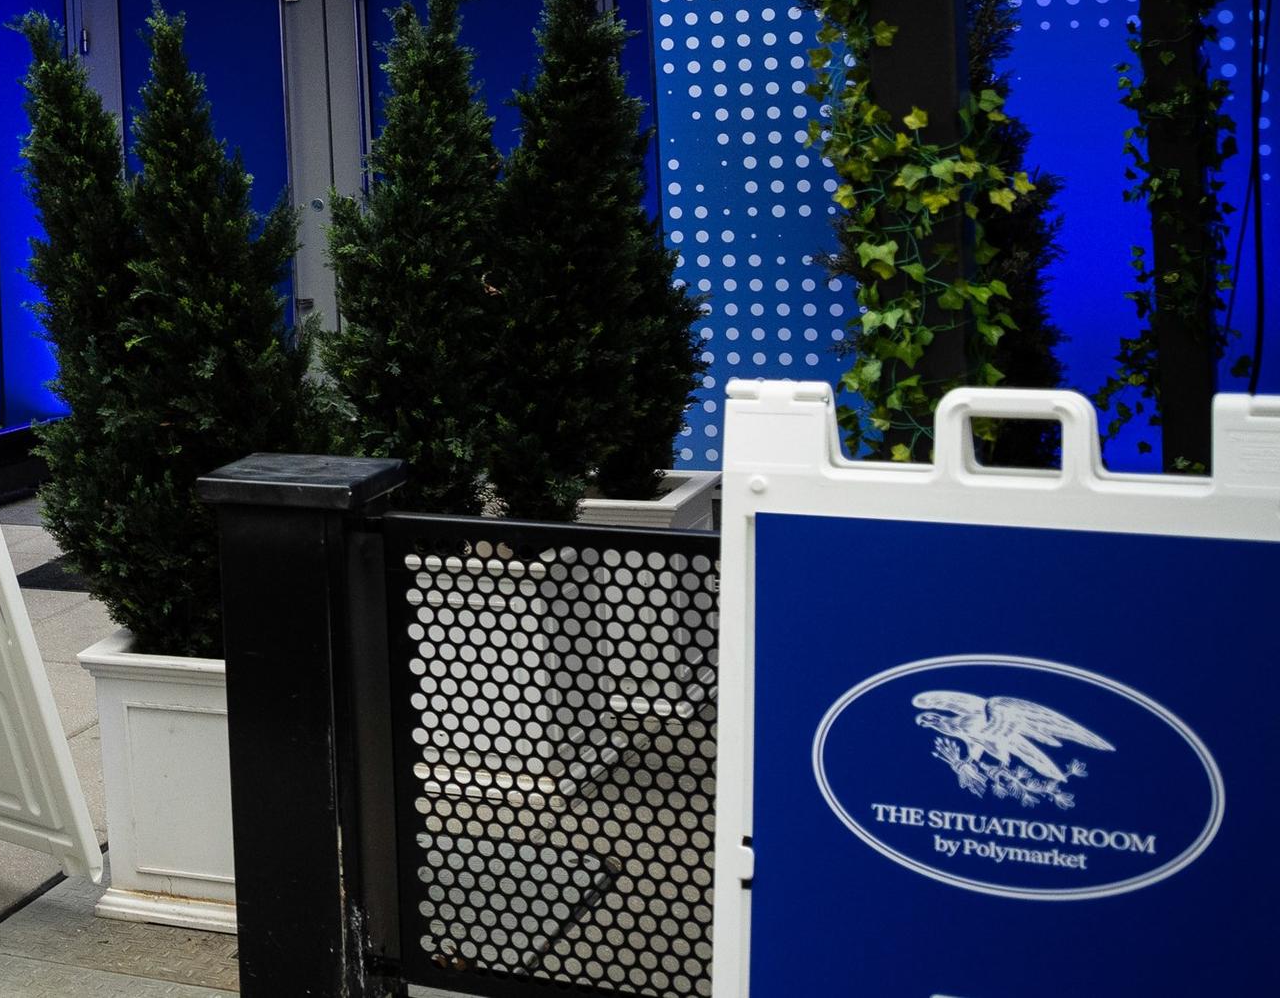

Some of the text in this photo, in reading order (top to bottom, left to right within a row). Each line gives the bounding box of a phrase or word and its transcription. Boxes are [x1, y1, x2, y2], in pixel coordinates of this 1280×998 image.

[871, 803, 1156, 854] THE SITUATION ROOM
[934, 834, 1087, 869] by Polymarket
